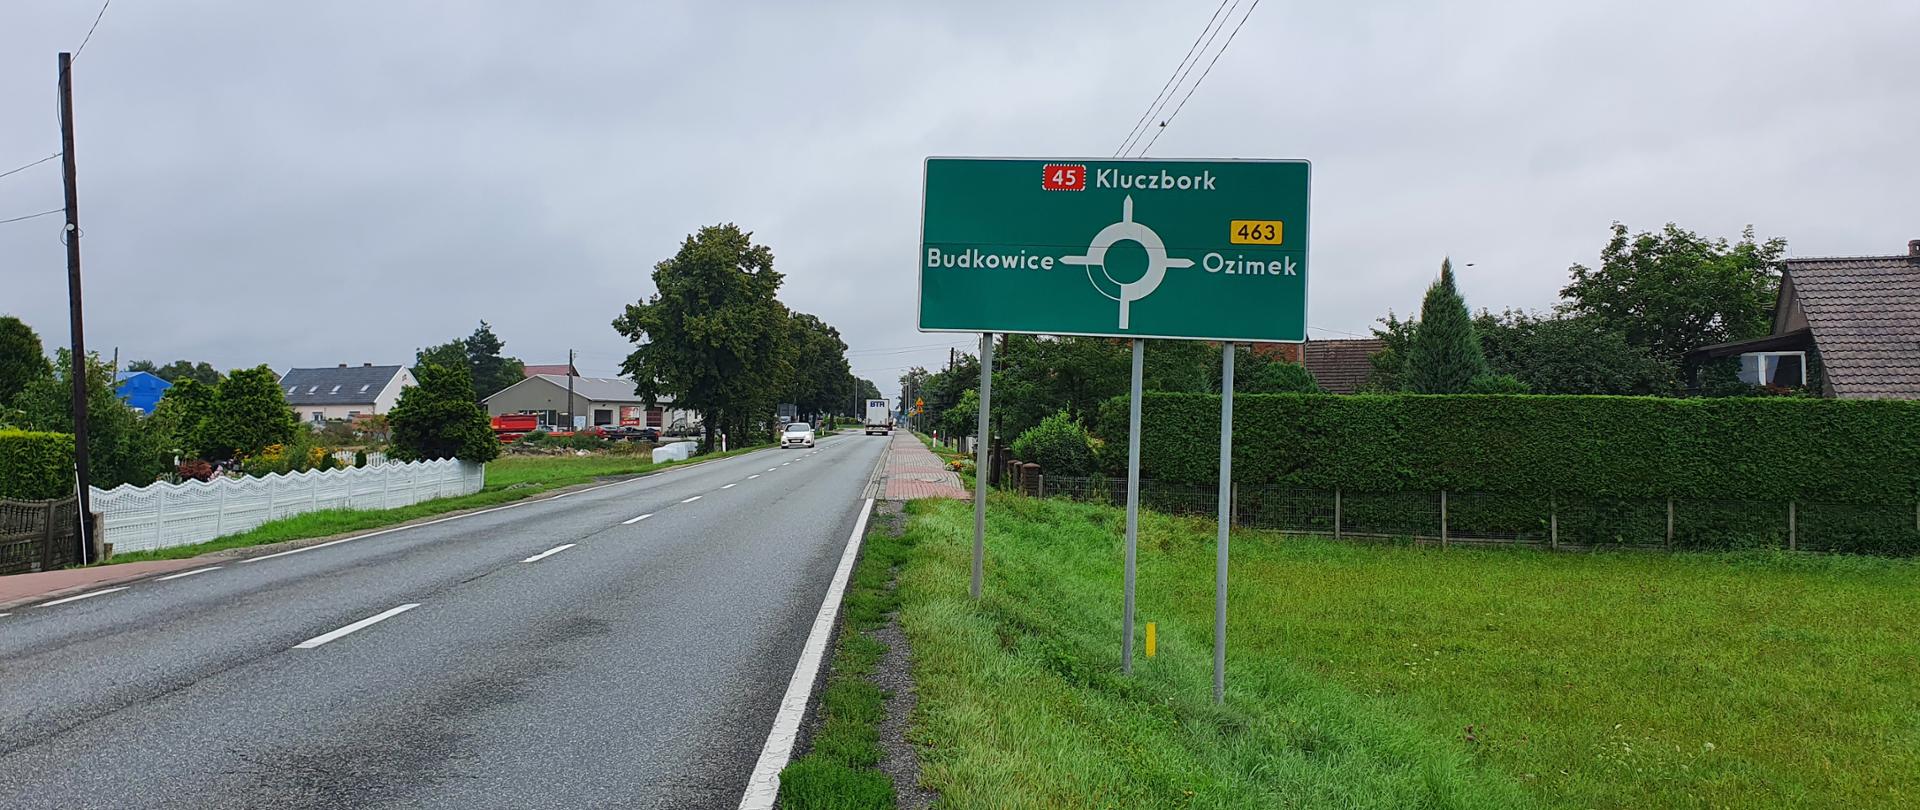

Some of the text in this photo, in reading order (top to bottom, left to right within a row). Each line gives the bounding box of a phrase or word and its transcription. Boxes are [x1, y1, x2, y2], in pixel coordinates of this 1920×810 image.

[1052, 168, 1216, 190] 45 Kluczbork
[1237, 224, 1276, 241] 463
[927, 248, 1054, 270] Budkowice
[1202, 252, 1297, 276] Ozimek
